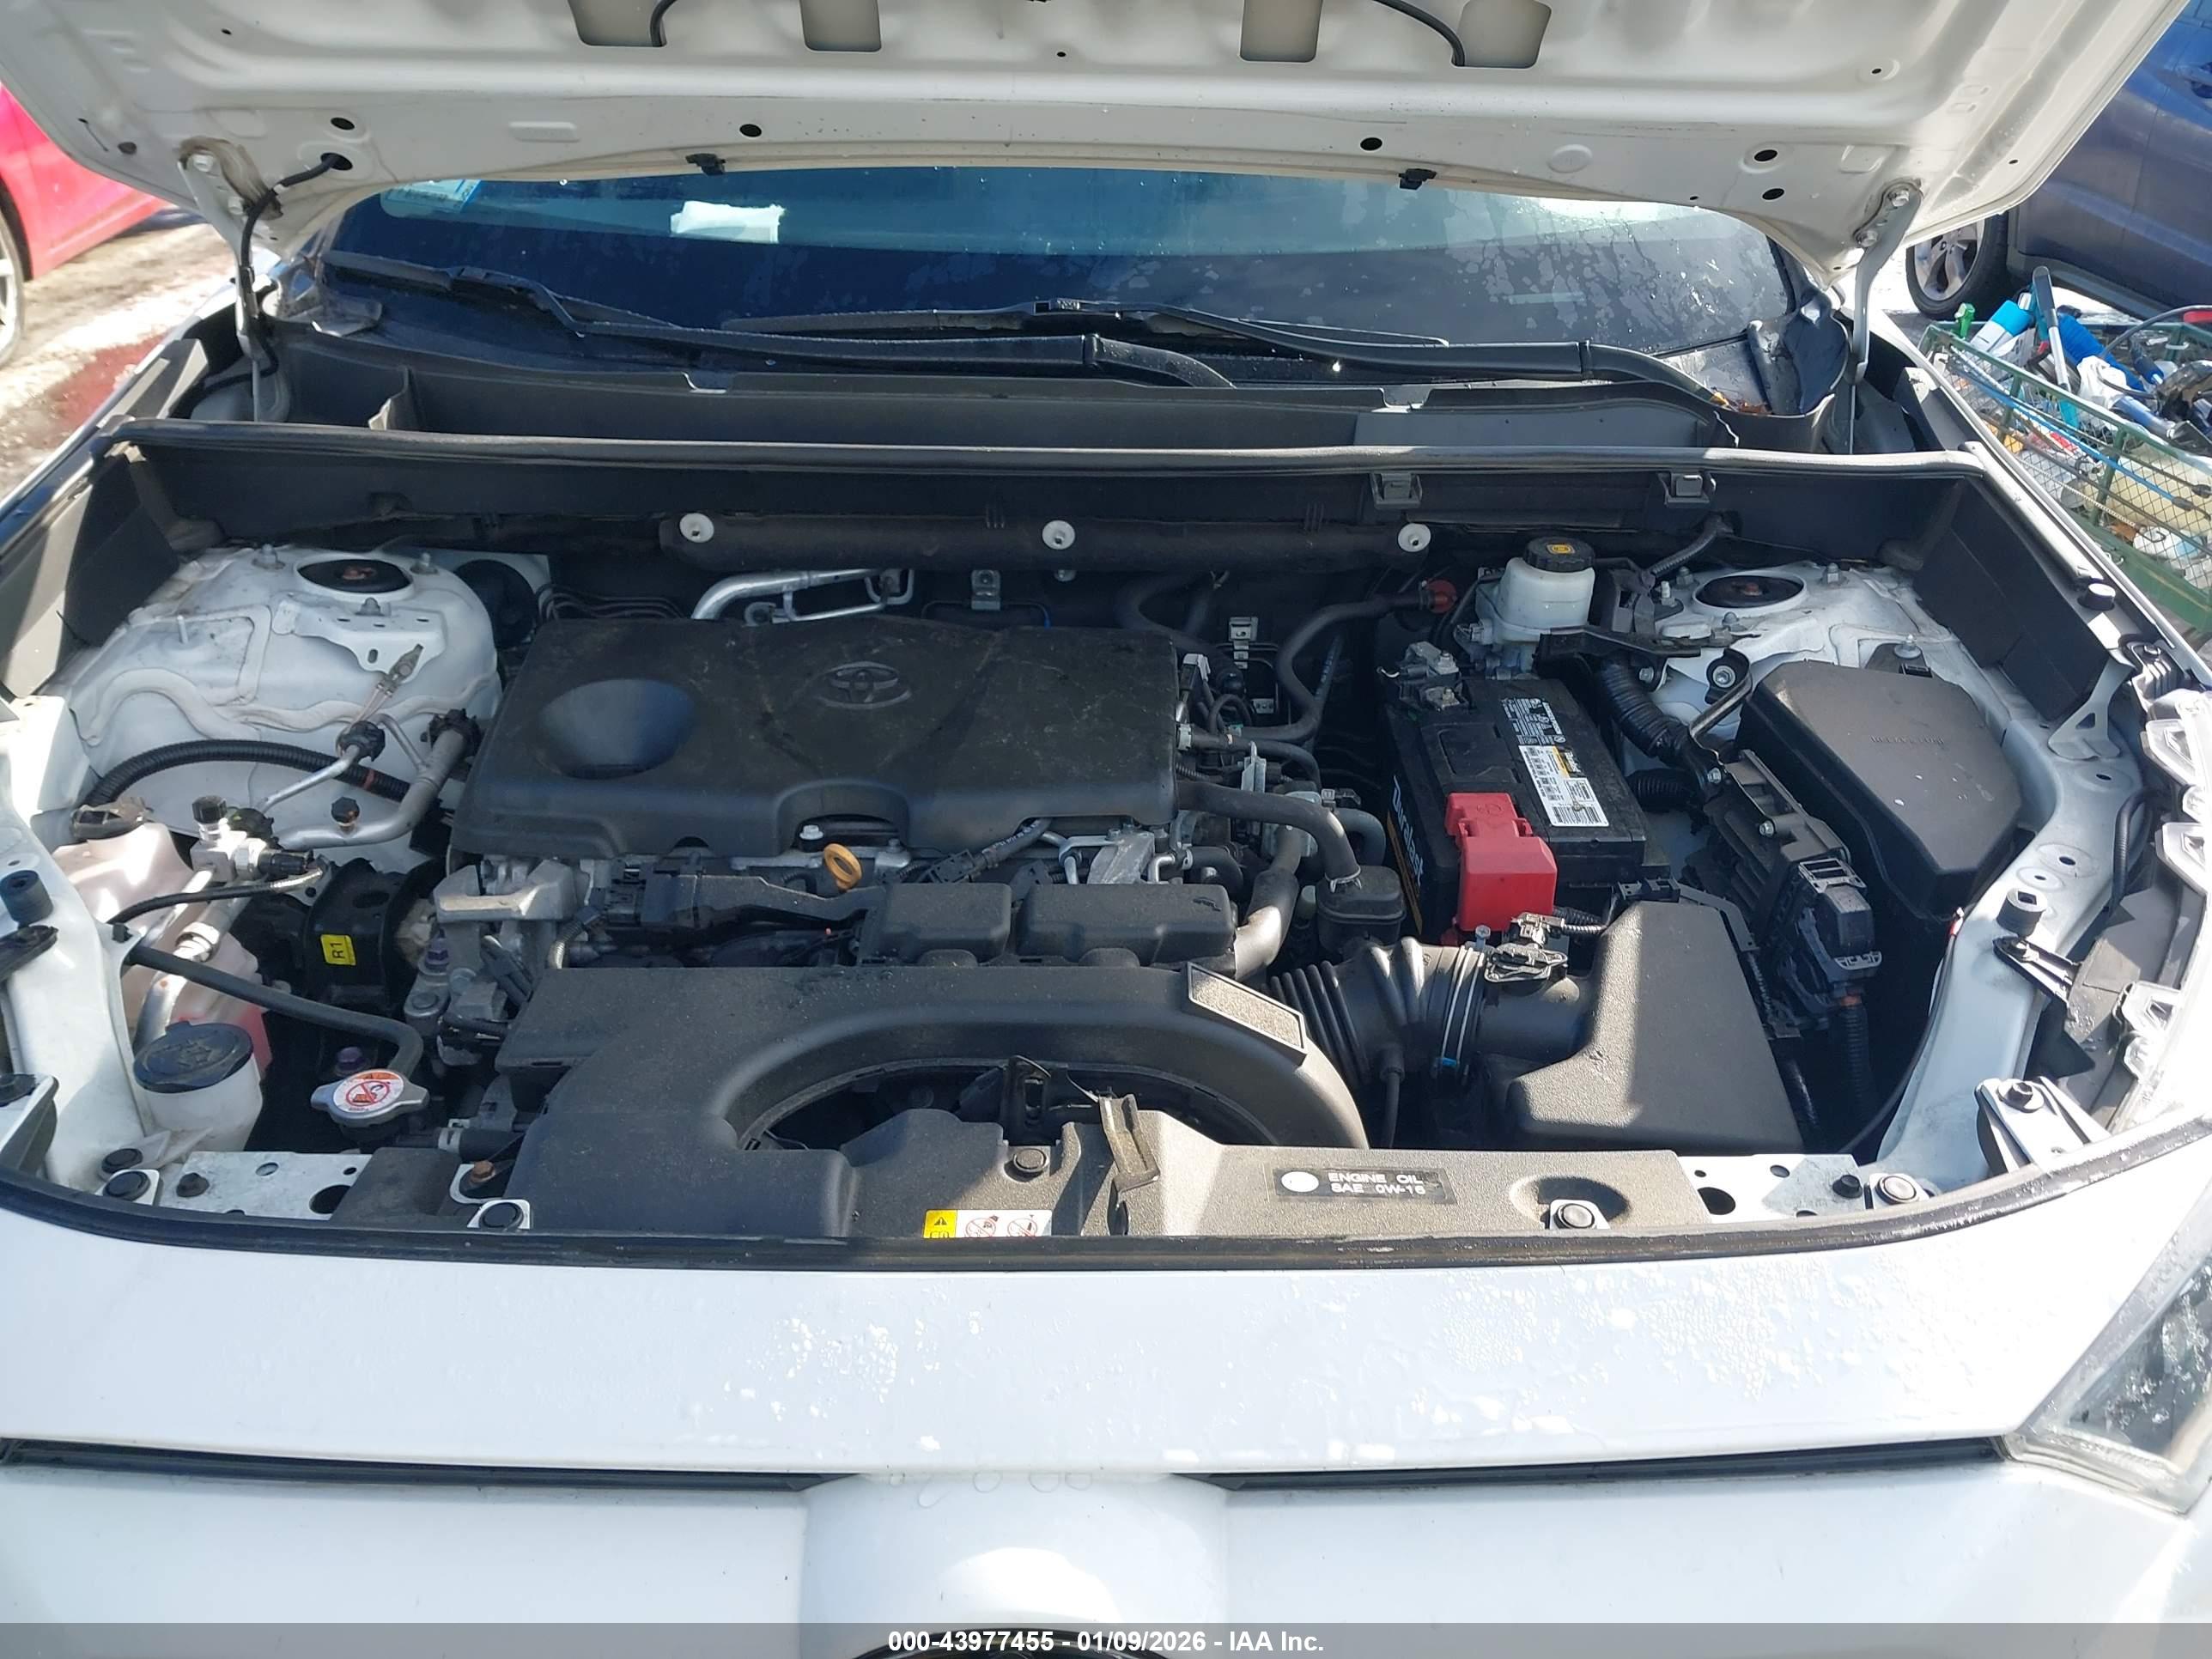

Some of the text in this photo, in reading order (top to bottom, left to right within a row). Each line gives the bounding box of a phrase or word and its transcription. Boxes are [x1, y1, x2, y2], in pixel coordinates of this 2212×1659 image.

[1393, 775, 1425, 887] Duralast
[330, 942, 345, 959] R1
[1328, 1172, 1424, 1185] ENGINE OIL
[1330, 1183, 1426, 1195] SAE 0W-16
